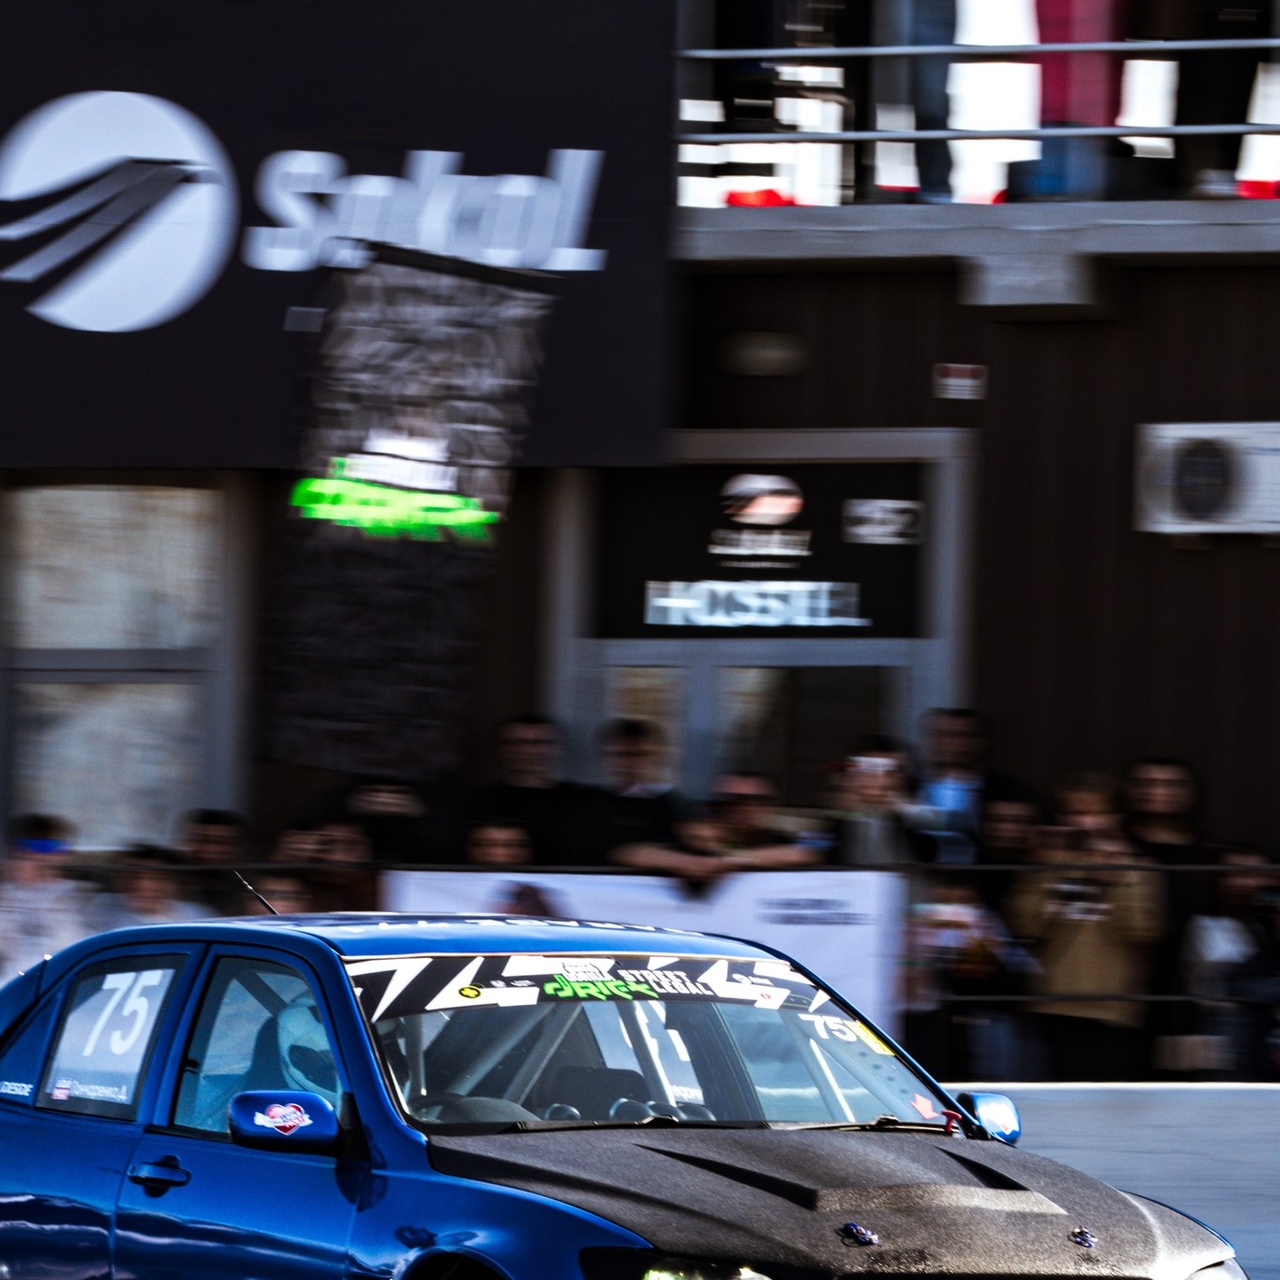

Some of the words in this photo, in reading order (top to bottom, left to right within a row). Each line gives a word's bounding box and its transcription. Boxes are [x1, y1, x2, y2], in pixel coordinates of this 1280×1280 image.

[617, 969, 689, 984] STREET
[649, 980, 715, 996] LEGAL
[82, 969, 163, 1057] 75
[798, 1013, 858, 1042] 75
